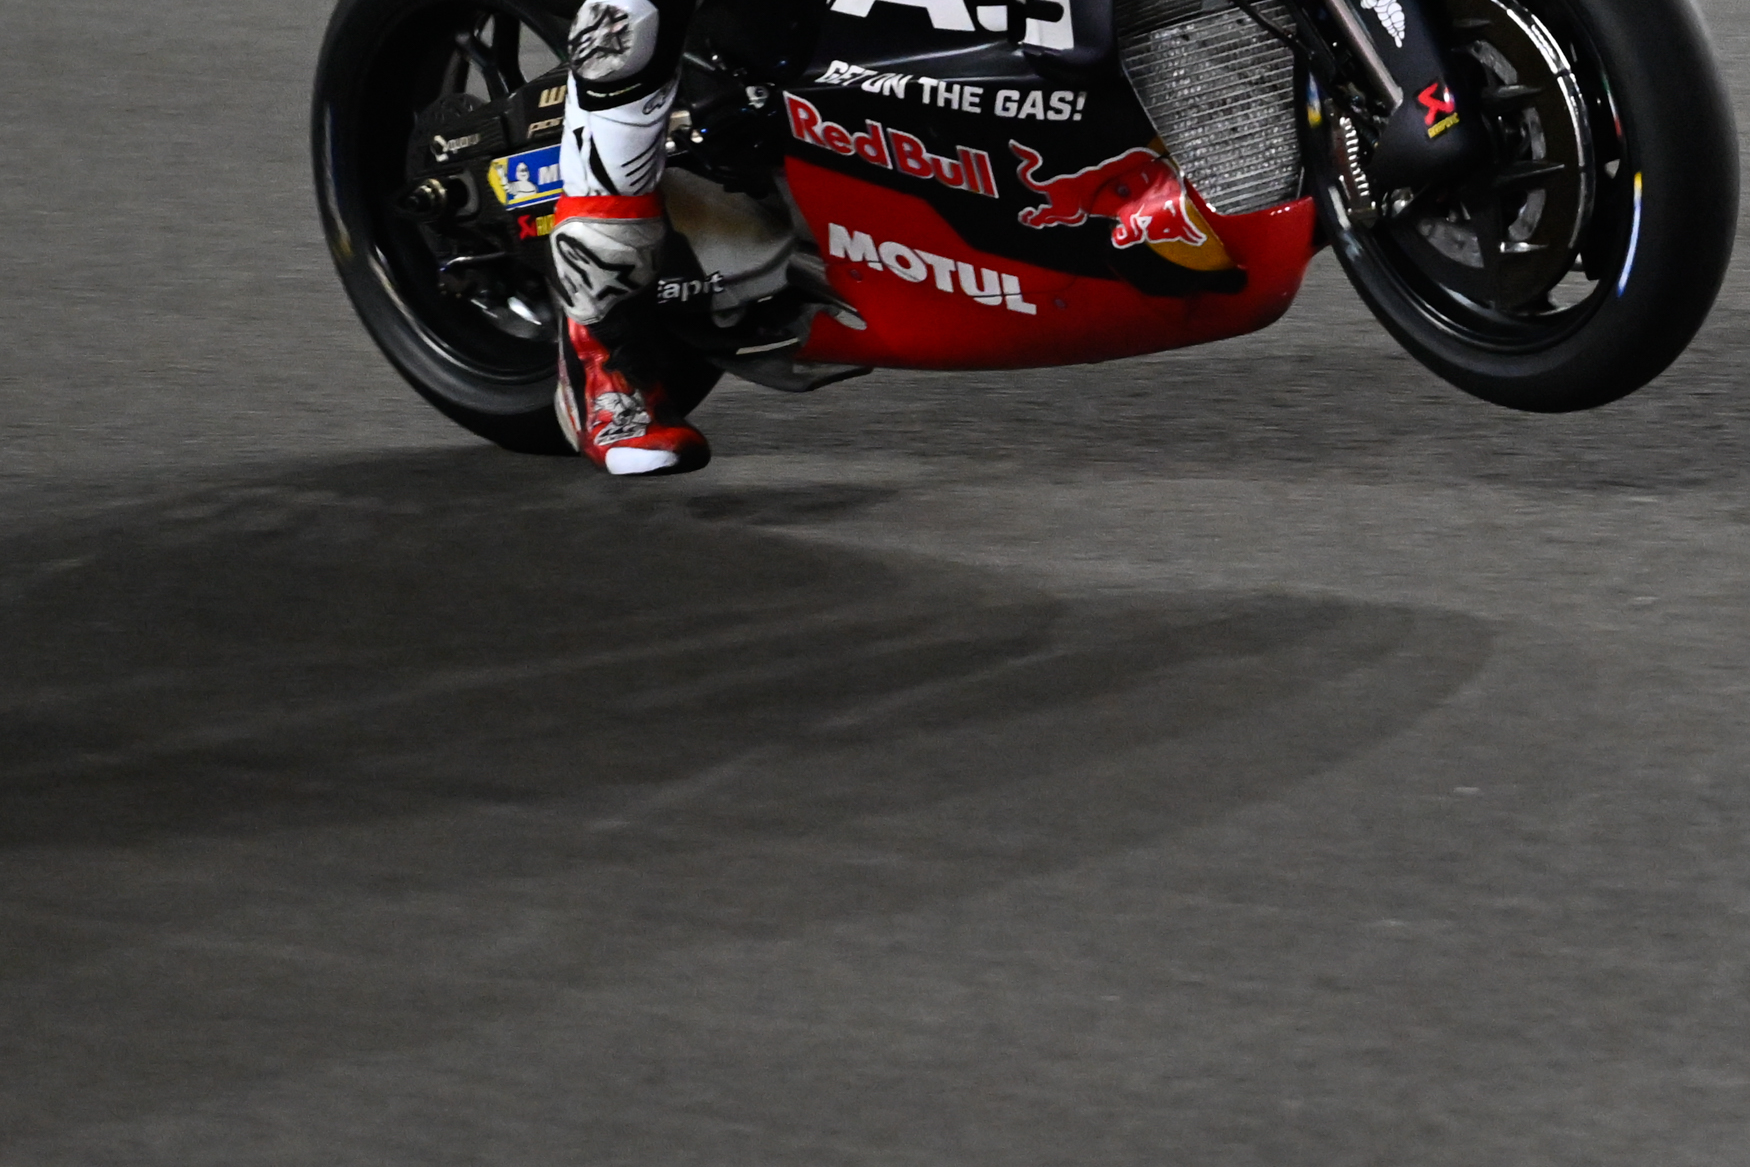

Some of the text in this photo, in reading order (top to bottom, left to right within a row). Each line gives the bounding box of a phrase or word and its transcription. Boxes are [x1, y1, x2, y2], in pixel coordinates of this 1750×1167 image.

[814, 60, 1088, 121] GET ON THE GAS!
[783, 90, 998, 199] Red Bull
[828, 222, 1037, 316] MOTUL
